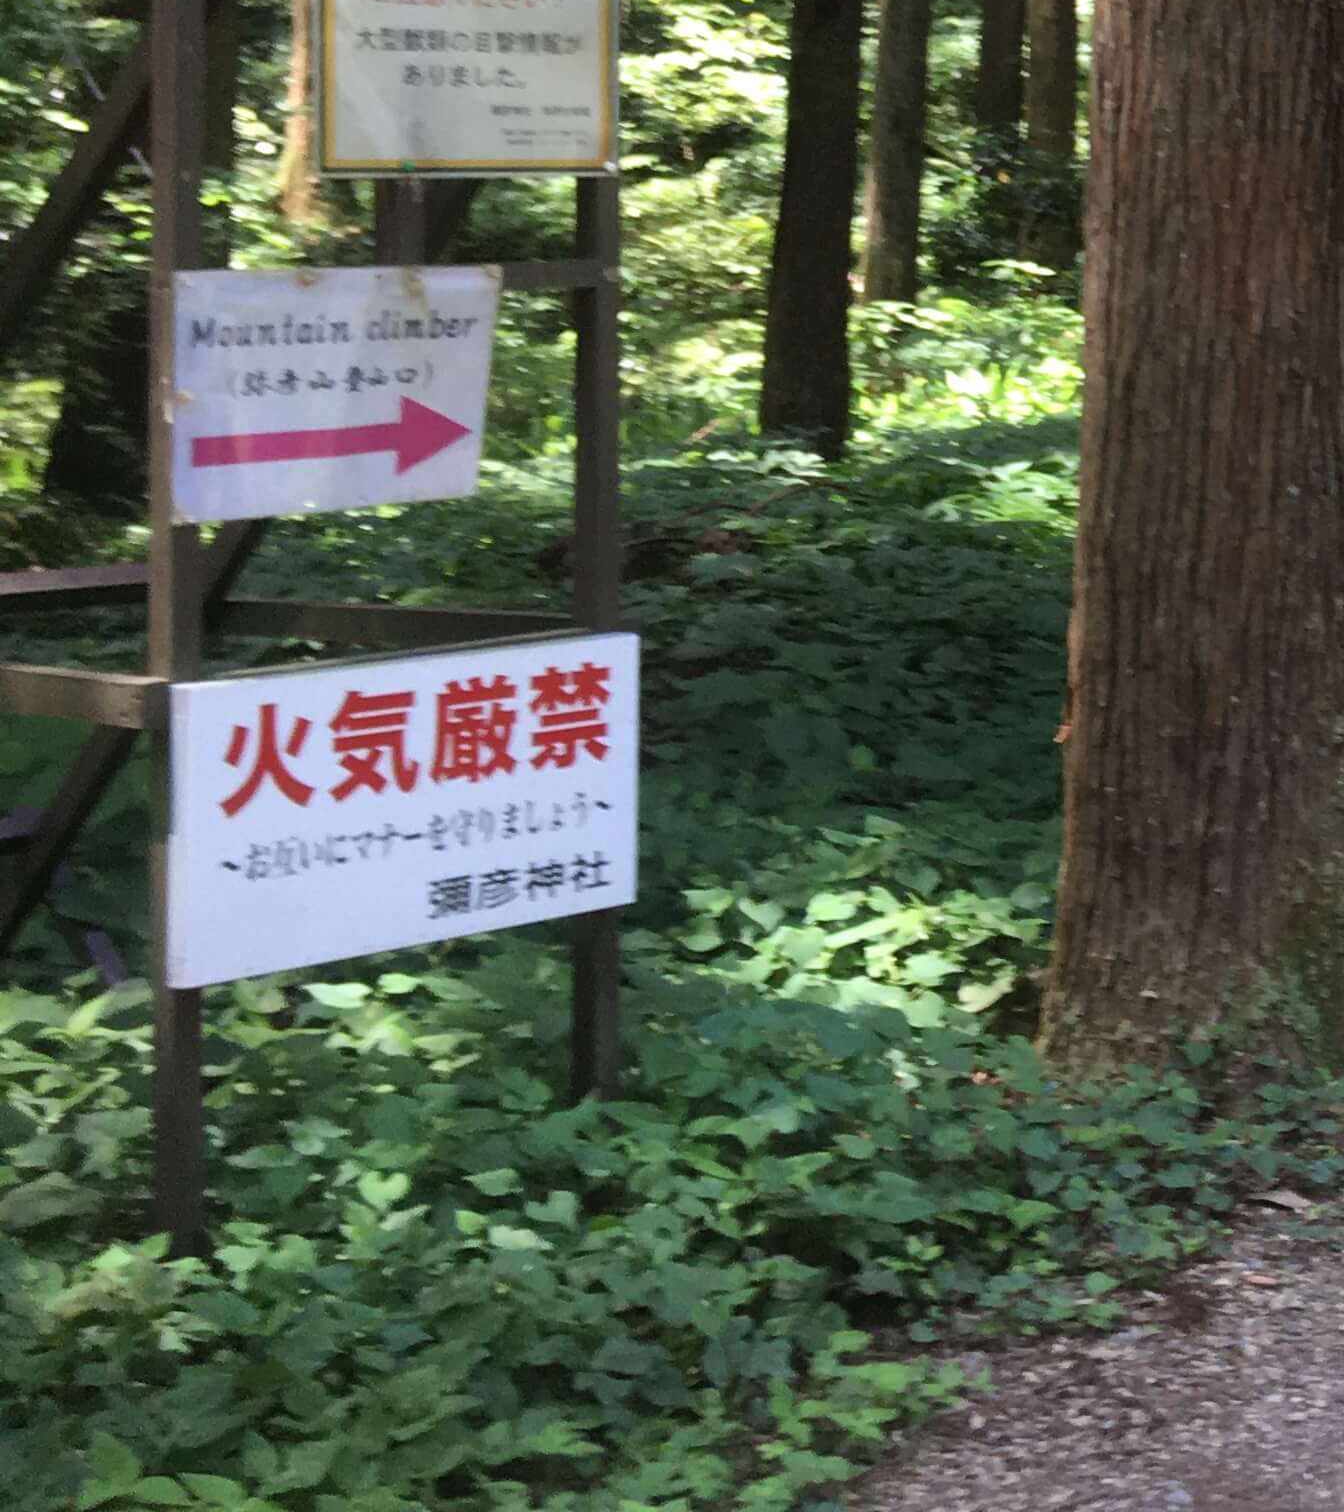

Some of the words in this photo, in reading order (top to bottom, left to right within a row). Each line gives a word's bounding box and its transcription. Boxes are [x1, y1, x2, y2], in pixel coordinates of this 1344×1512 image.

[190, 312, 350, 348] Mountain
[219, 661, 611, 818] 火気厳禁
[427, 850, 612, 920] 彌彦神社
